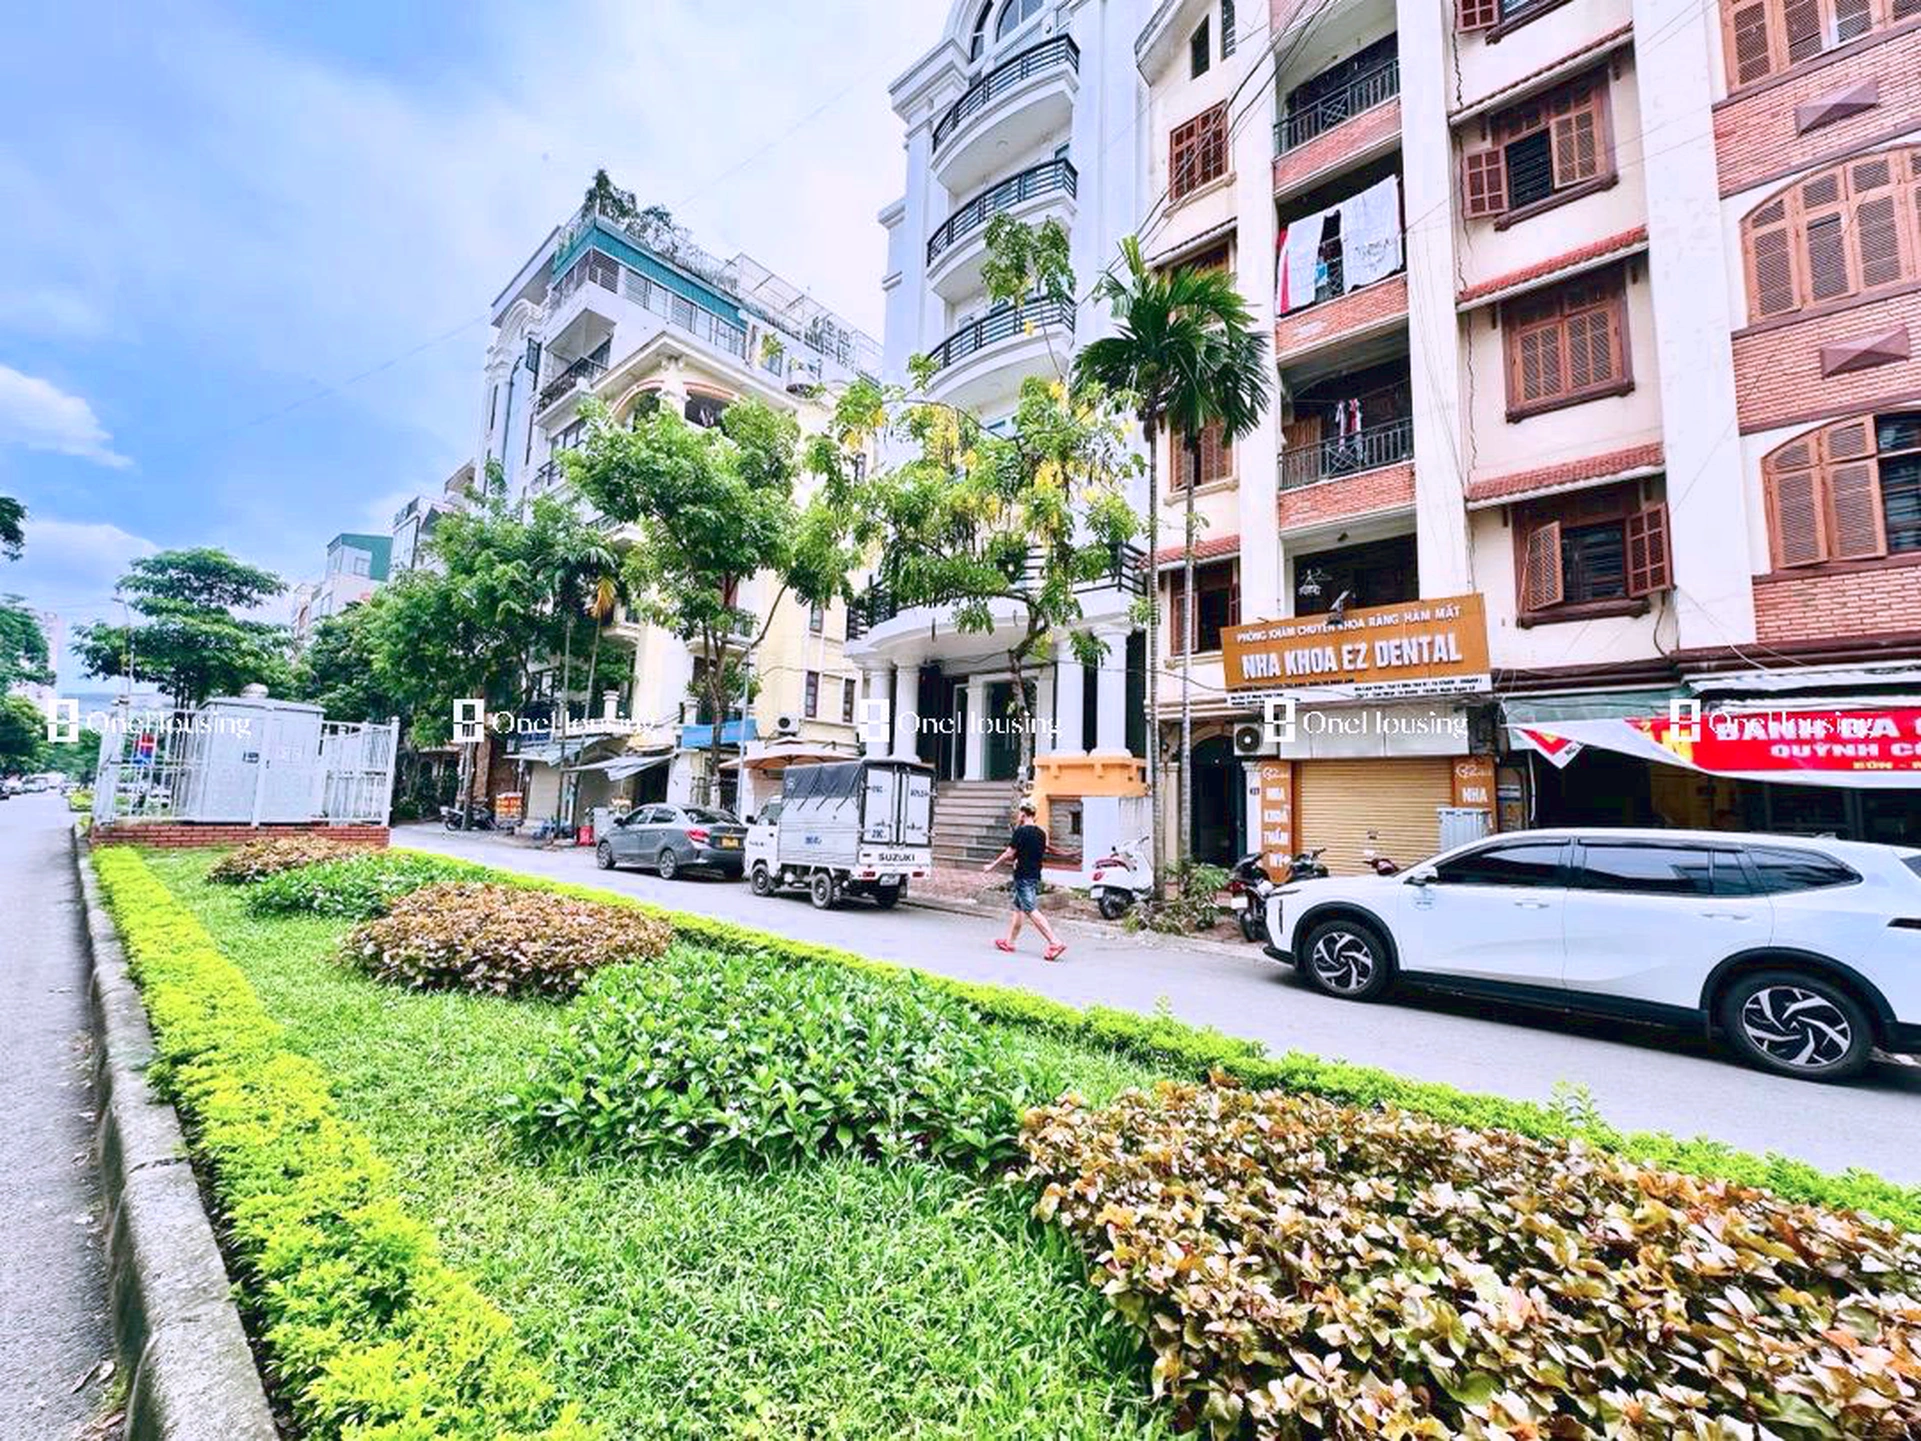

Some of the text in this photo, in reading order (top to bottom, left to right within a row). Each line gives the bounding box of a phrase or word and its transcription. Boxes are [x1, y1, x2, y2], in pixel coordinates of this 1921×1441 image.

[1241, 632, 1463, 680] NHA KHOA EZ DENTAL
[1462, 787, 1488, 803] NHA
[878, 852, 915, 862] SUZUKI
